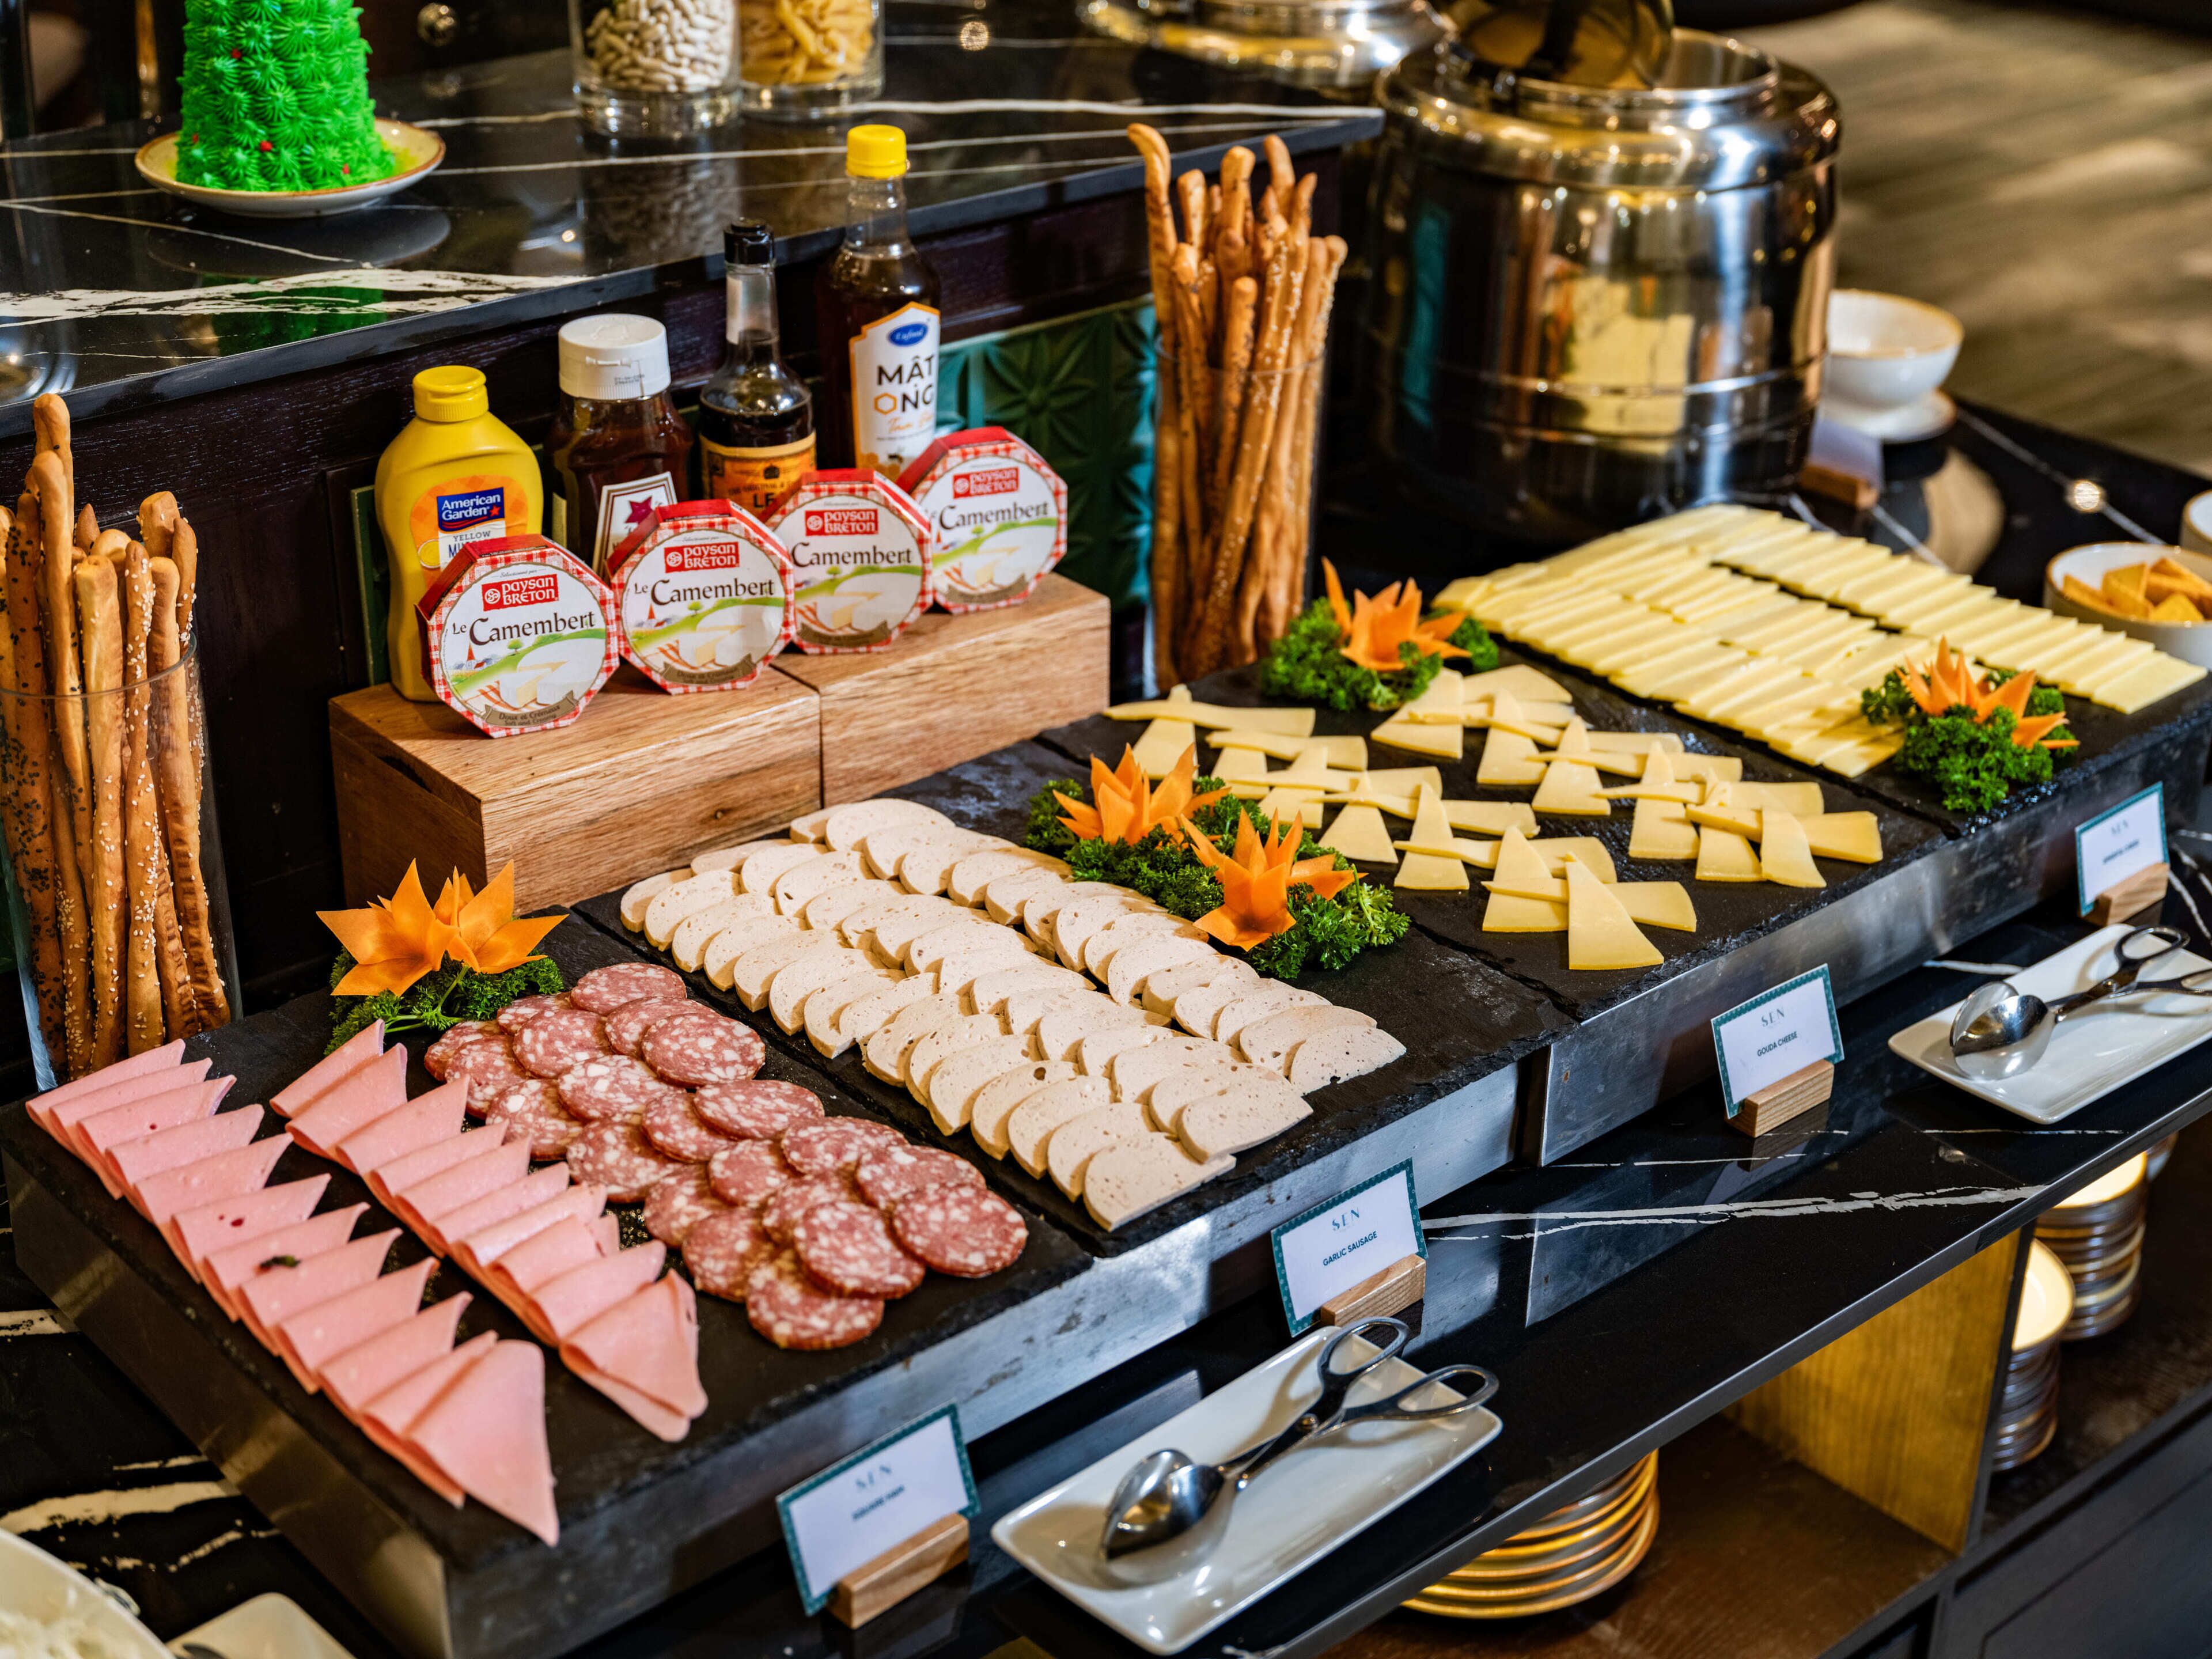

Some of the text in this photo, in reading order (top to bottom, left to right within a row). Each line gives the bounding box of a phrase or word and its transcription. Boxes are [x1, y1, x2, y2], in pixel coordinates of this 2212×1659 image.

[442, 494, 501, 510] American
[442, 506, 488, 521] Garden
[939, 501, 1048, 530] Camembert
[453, 531, 491, 542] YELLOW
[791, 542, 912, 567] Camembert
[634, 577, 775, 606] Le Camembert
[452, 611, 595, 646] Le Camembert
[1757, 1031, 1798, 1057] GOUDA CHEESE
[1323, 1230, 1377, 1266] GARLIC SAUSAGE
